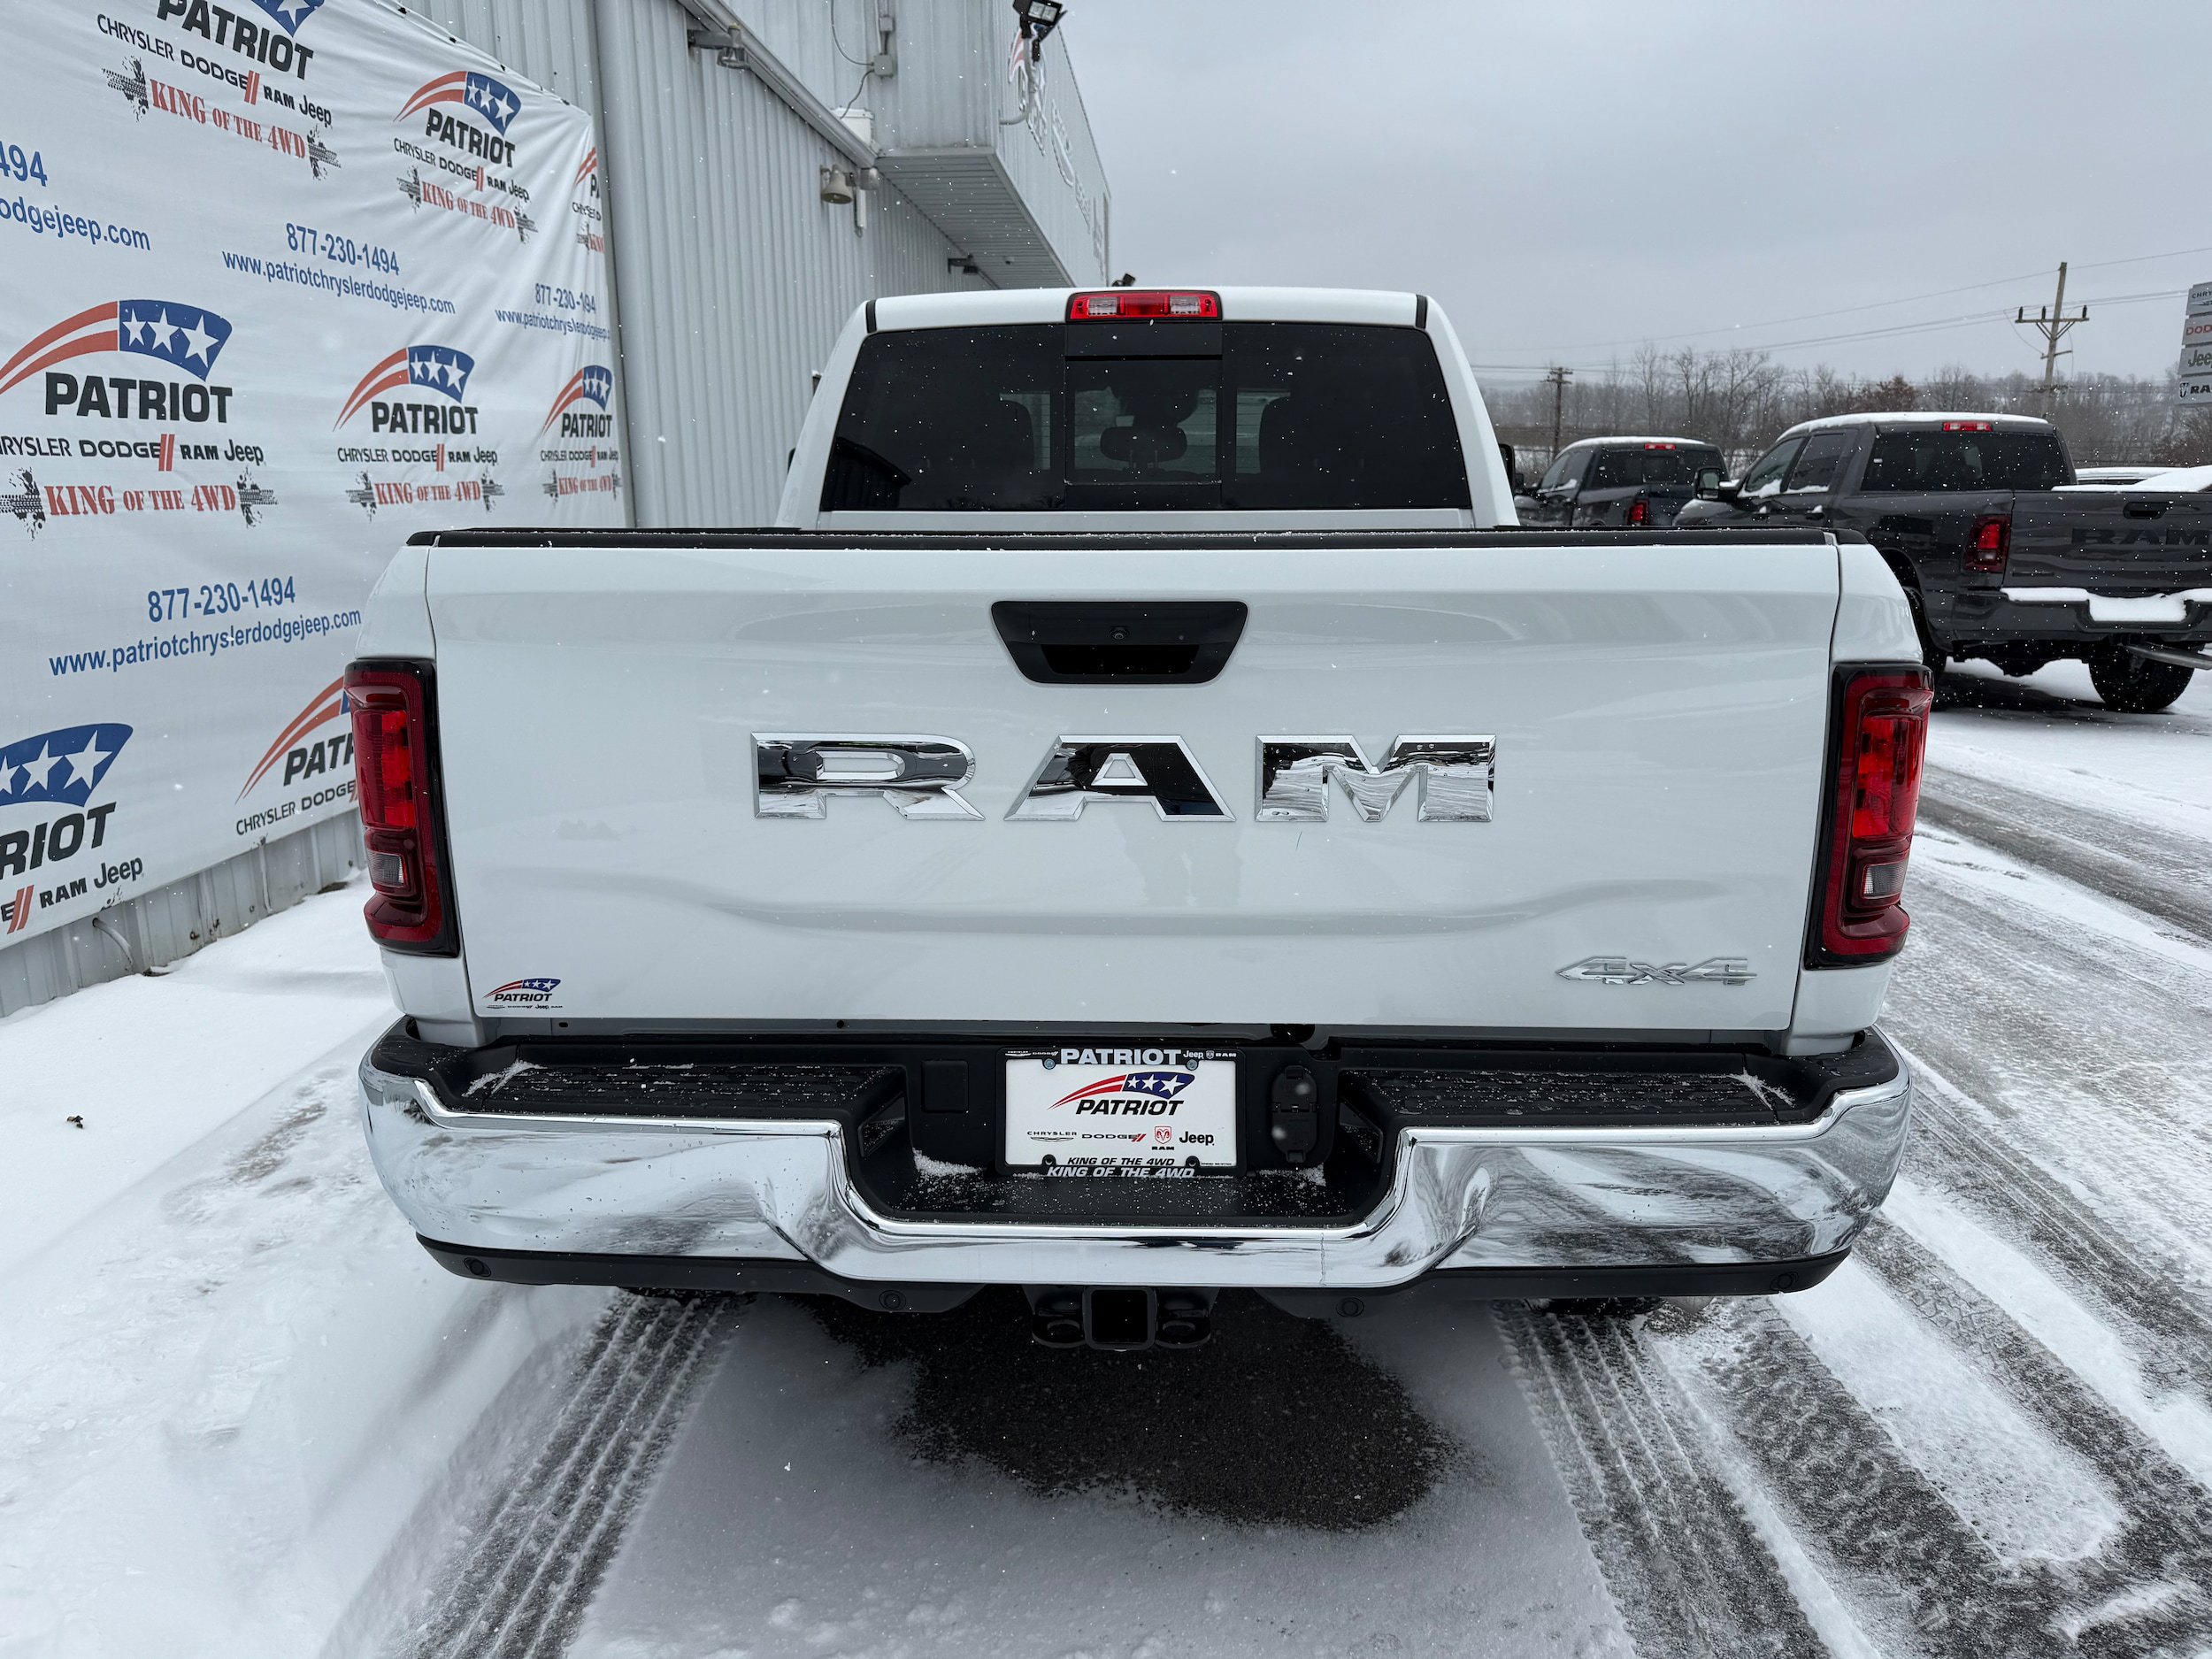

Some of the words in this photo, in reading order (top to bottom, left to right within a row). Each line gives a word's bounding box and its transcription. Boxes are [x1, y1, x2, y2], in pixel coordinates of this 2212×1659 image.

[157, 0, 314, 81] PATRIOT
[97, 13, 175, 62] CHRYSLER
[180, 50, 250, 90] DODGE
[263, 84, 296, 111] RAM
[299, 94, 333, 129] Jeep
[149, 79, 207, 125] KING
[211, 106, 230, 132] OF
[234, 115, 263, 142] THE
[267, 124, 307, 159] 4WD
[425, 107, 516, 168] PATRIOT
[394, 137, 436, 166] CHRYSLER
[439, 157, 479, 182] DODGE
[487, 175, 507, 193] RAM
[508, 177, 531, 203] Jeep
[422, 182, 455, 211] KING
[457, 197, 469, 215] OF
[470, 200, 489, 221] THE
[490, 204, 516, 230] 4WD
[286, 222, 400, 277] 877-230-1494
[221, 250, 456, 314] www.patriotchryslerdodgejeep.com
[2187, 349, 2212, 369] Jee
[44, 372, 234, 424] PATRIOT
[2190, 384, 2212, 395] RA
[371, 401, 479, 435] PATRIOT
[561, 413, 613, 438] PATRIOT
[79, 439, 161, 459] DODGE
[180, 443, 219, 461] RAM
[224, 439, 265, 466] Jeep
[337, 447, 389, 463] CHRYSLER
[392, 449, 438, 463] DODGE
[448, 451, 471, 463] RAM
[473, 445, 497, 466] Jeep
[43, 484, 116, 517] KING
[122, 490, 144, 512] OF
[148, 490, 185, 511] THE
[190, 484, 236, 512] 4WD
[374, 481, 413, 505] KING
[417, 486, 429, 502] OF
[430, 485, 452, 502] THE
[455, 480, 481, 502] 4WD
[2071, 527, 2209, 545] RAM
[148, 575, 296, 623] 877-230-1494
[49, 609, 363, 676] www.patriotchryslerdodgejeep.com
[750, 731, 1499, 823] RAM
[235, 801, 296, 836] CHRYSLER
[301, 779, 356, 812] DODGE
[40, 877, 88, 910] RAM
[94, 856, 143, 889] Jeep
[1060, 1048, 1183, 1065] PATRIOT
[1183, 1049, 1204, 1060] Jeep
[1075, 1099, 1184, 1116] PATRIOT
[1179, 1132, 1215, 1147] Jeep
[1047, 1166, 1093, 1178] KING
[1093, 1166, 1119, 1178] OF
[1119, 1167, 1150, 1178] THE
[1154, 1167, 1195, 1179] 4WD
[1067, 1157, 1099, 1166] KING
[1146, 1157, 1175, 1166] 4WD
